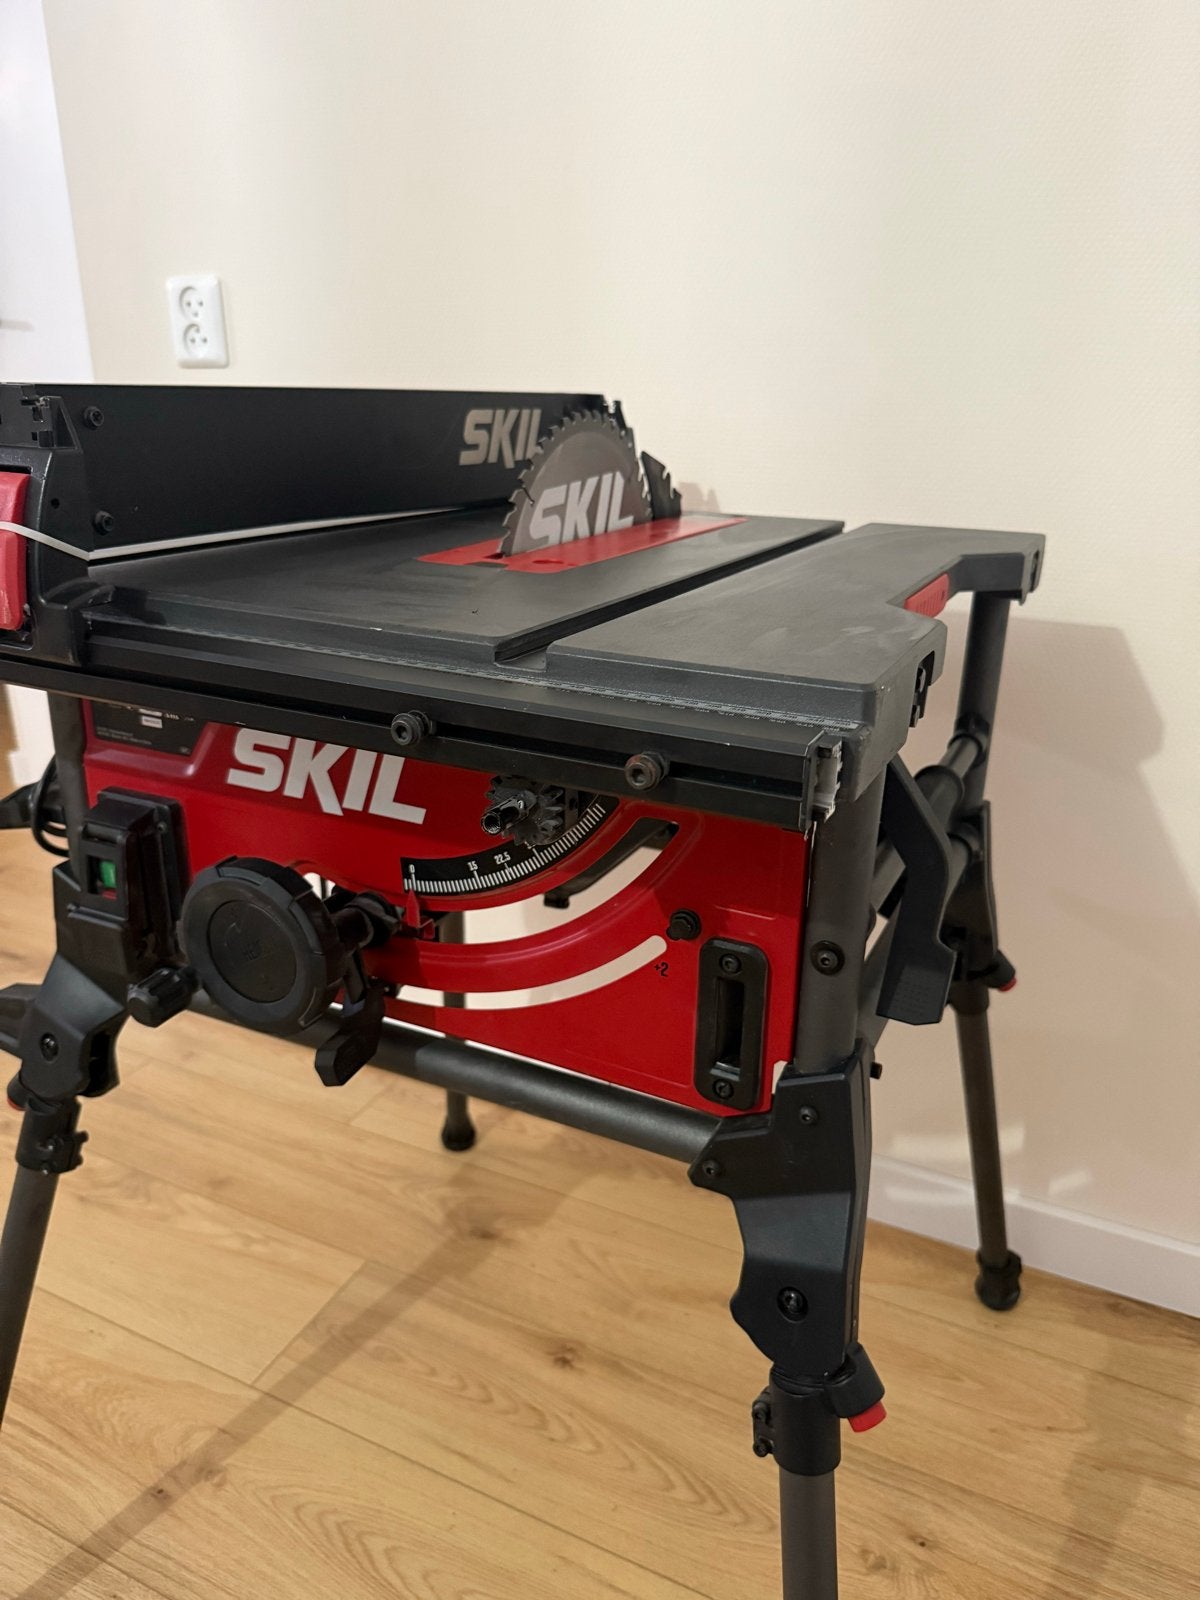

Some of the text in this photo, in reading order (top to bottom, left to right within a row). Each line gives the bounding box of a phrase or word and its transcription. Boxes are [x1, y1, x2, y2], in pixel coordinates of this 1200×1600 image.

[459, 409, 542, 469] SKIL
[529, 471, 634, 546] SKIL
[227, 727, 426, 825] SKIL
[467, 861, 478, 871] 15
[494, 851, 511, 865] 22.5
[408, 864, 416, 873] 0
[653, 961, 669, 977] +2
